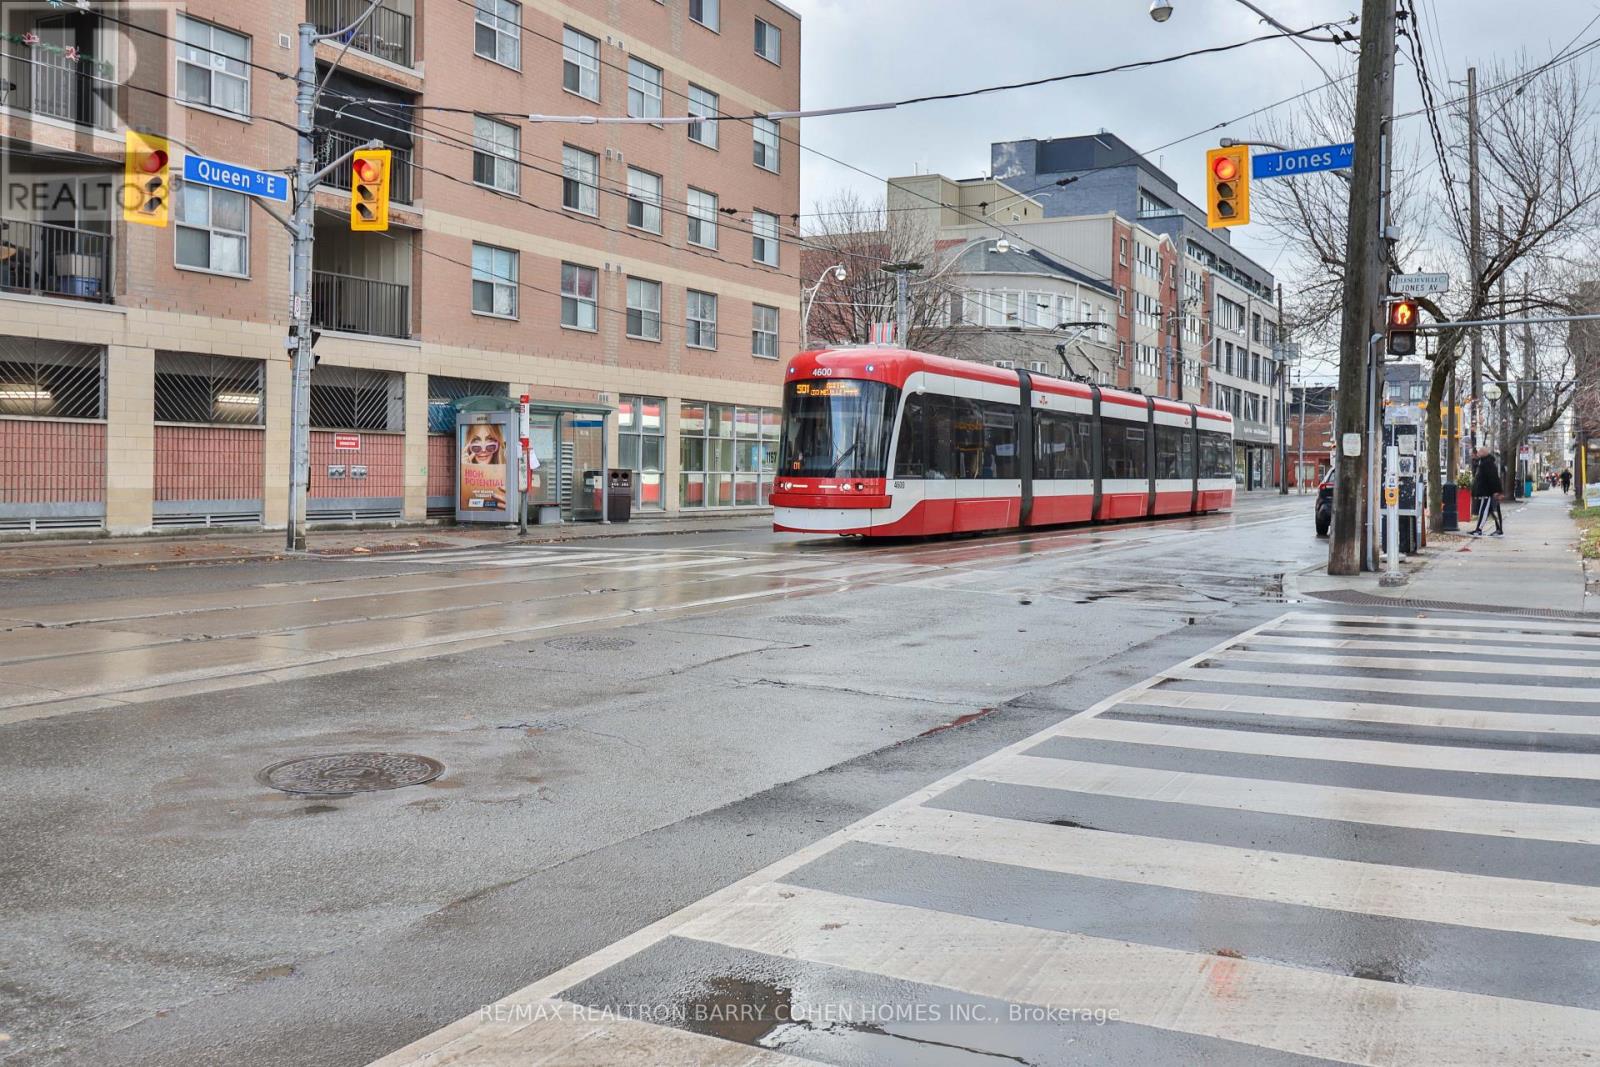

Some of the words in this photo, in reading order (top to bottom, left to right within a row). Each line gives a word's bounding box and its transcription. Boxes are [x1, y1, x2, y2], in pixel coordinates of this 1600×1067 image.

[1276, 152, 1331, 172] Jones
[1340, 146, 1353, 156] Av
[198, 161, 250, 188] Queen
[256, 173, 265, 184] St
[266, 176, 275, 194] E
[1401, 284, 1425, 292] JONES
[812, 367, 833, 377] 4600
[796, 384, 810, 394] 501
[465, 468, 484, 478] HIGH
[465, 478, 504, 488] POTENTIAL
